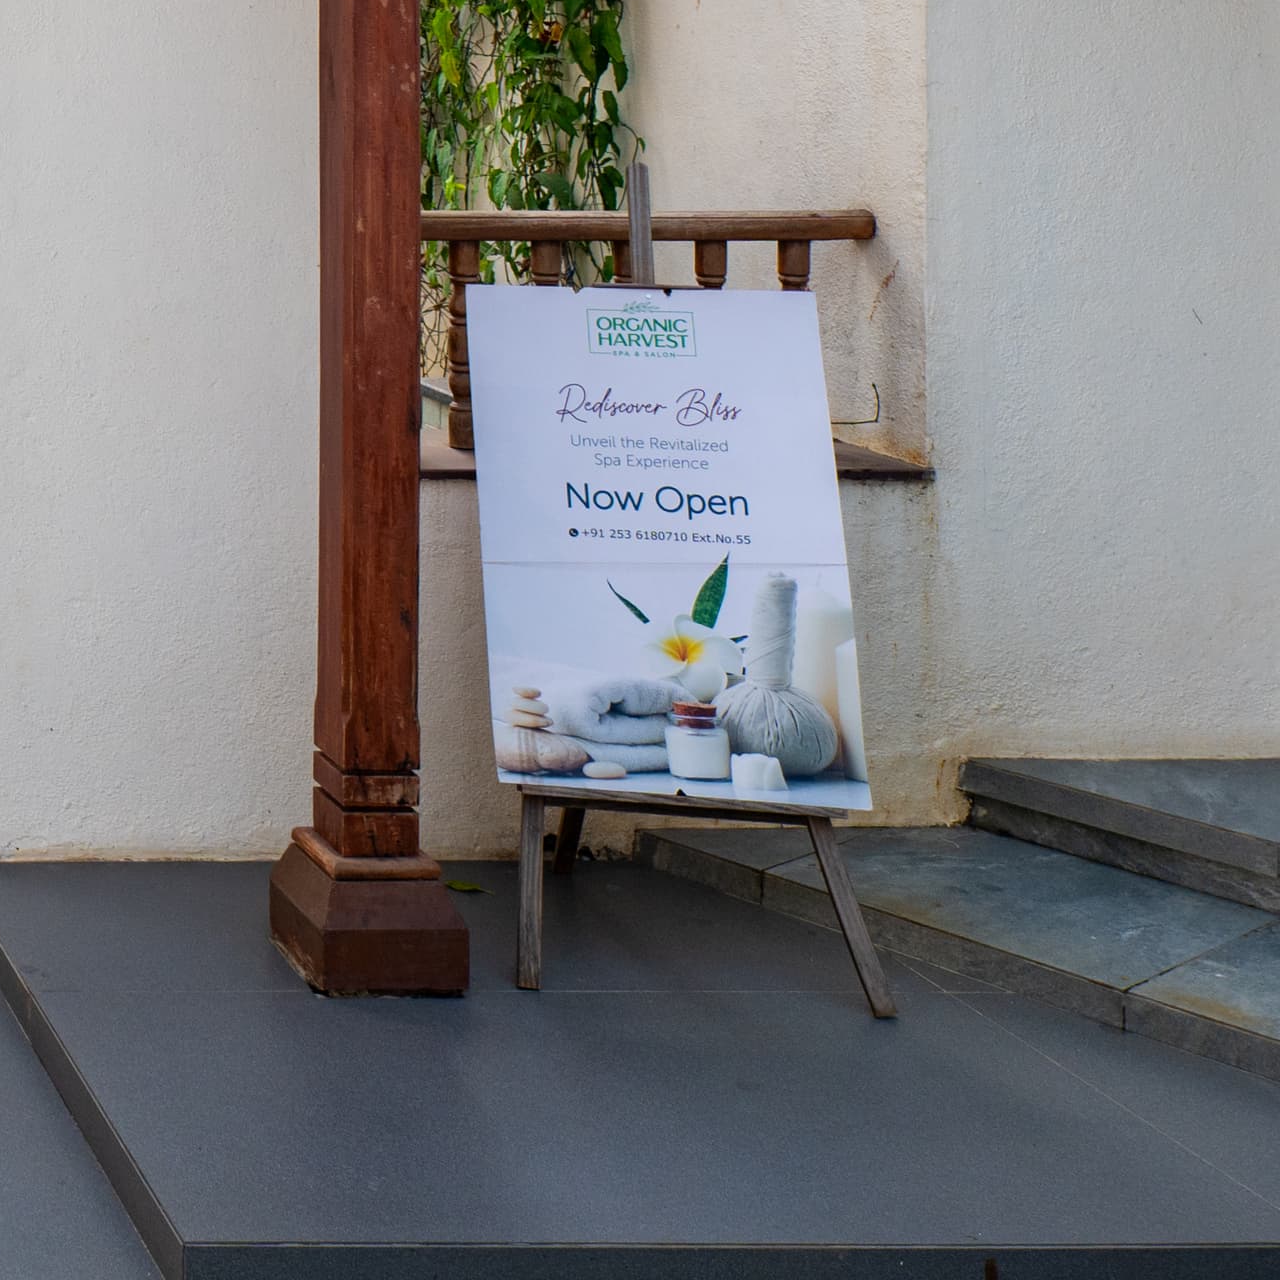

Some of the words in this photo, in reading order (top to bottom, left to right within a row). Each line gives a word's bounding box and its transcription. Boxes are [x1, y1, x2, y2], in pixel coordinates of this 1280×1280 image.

[596, 316, 688, 333] ORGANIC
[598, 332, 689, 349] HARVEST
[556, 383, 666, 424] Rediscover
[675, 388, 742, 426] Bliss
[570, 434, 616, 448] Unveil
[621, 435, 645, 450] the
[650, 437, 729, 452] Revitalized
[595, 453, 621, 469] Spa
[627, 455, 710, 470] Experience
[566, 482, 644, 511] Now
[655, 486, 750, 520] Open
[582, 528, 605, 538] +91
[610, 528, 632, 539] 253
[636, 530, 688, 542] 6180710
[692, 532, 752, 545] Ext.No.55
